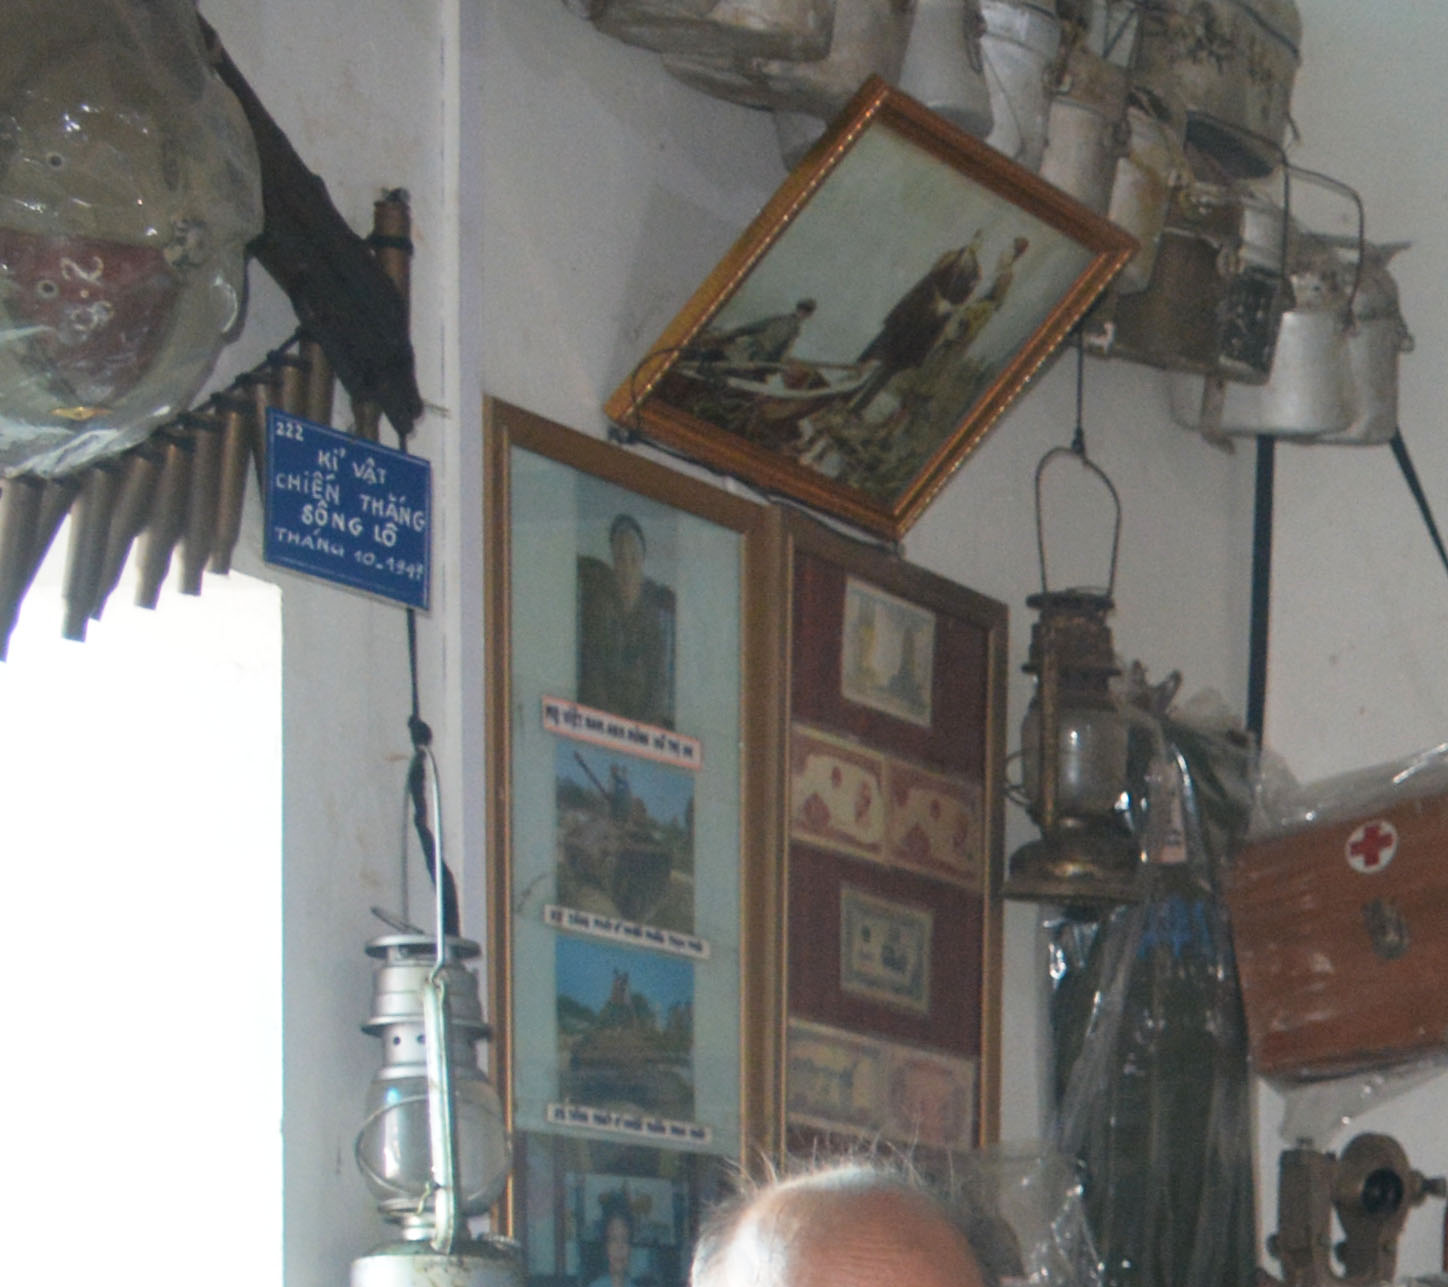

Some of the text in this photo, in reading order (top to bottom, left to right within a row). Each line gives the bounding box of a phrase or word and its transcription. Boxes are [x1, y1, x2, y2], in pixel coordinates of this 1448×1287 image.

[276, 422, 304, 441] 222
[352, 457, 386, 485] VẬT
[302, 500, 398, 547] SÔNG LÔ
[360, 493, 426, 532] THẮNG
